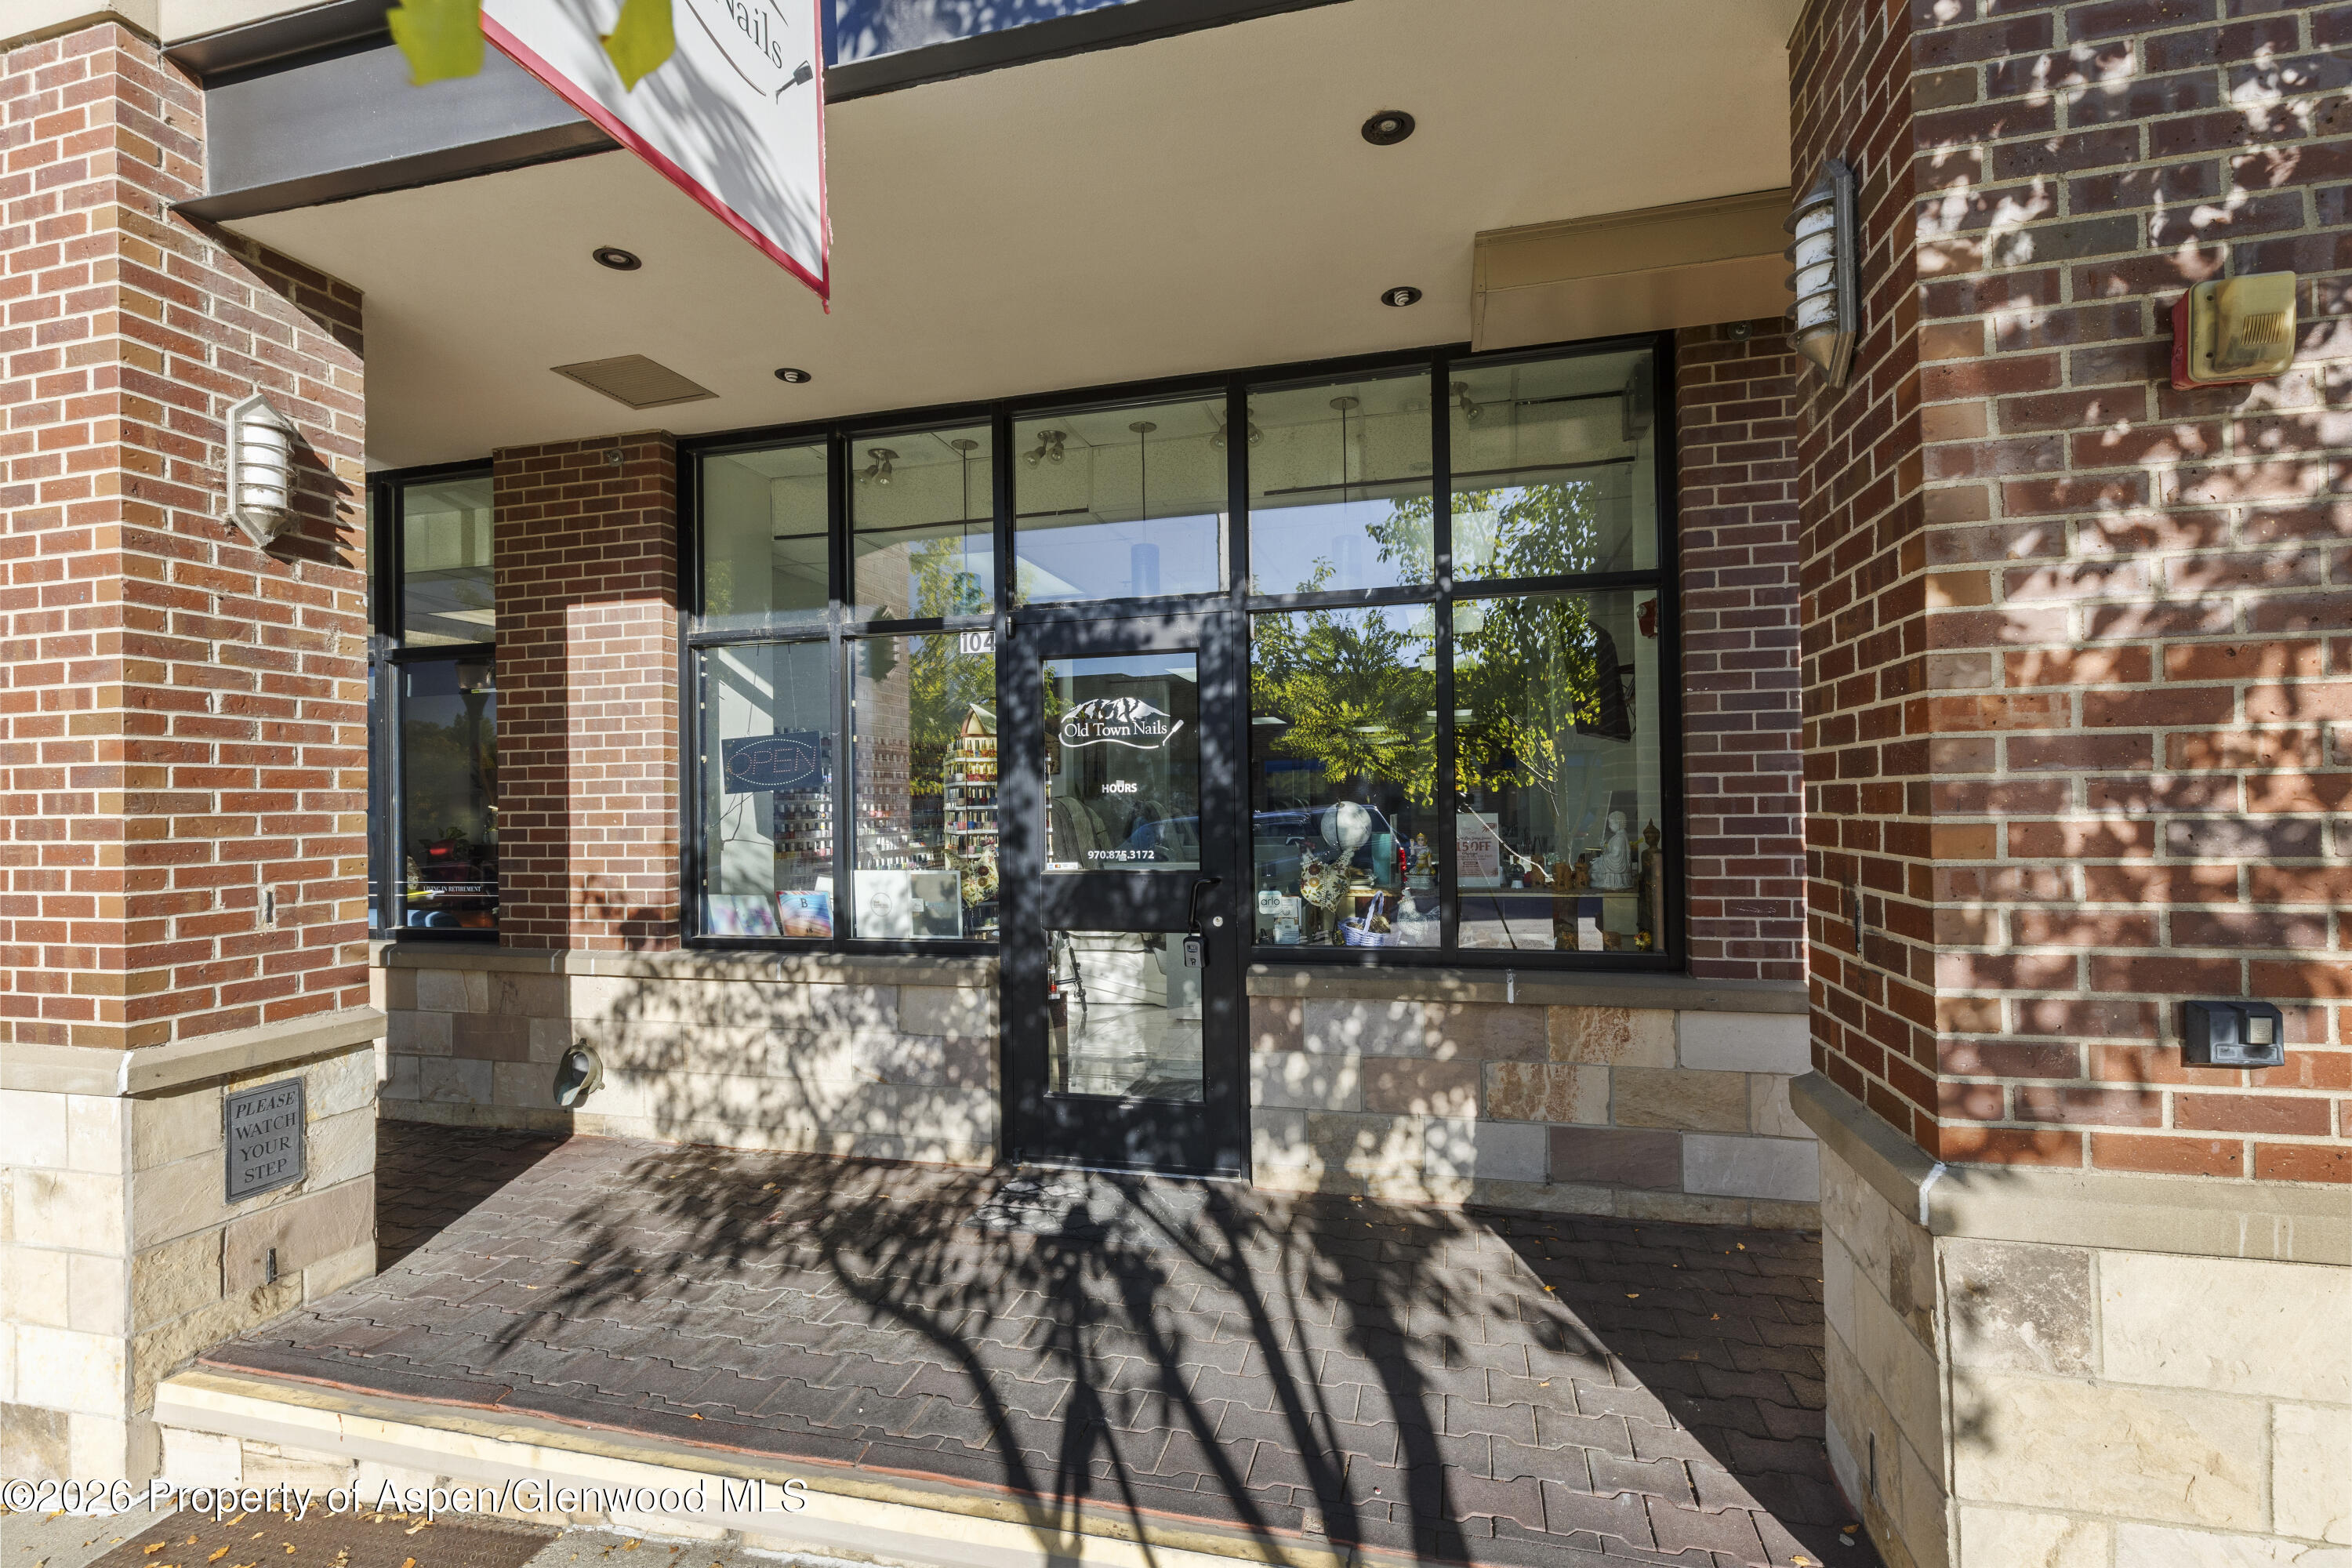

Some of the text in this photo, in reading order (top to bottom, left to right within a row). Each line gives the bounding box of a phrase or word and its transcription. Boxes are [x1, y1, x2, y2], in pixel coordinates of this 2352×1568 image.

[961, 631, 995, 652] 104
[1064, 720, 1167, 738] Old Town Nails
[727, 746, 817, 776] OPEN
[1102, 782, 1138, 793] HOURS
[1087, 850, 1155, 859] 970.875.3172
[1471, 841, 1491, 851] OFF
[1261, 896, 1280, 906] arlo
[234, 1091, 296, 1120] PLEASE
[236, 1112, 296, 1141] WATCH
[240, 1136, 292, 1162] YOUR
[244, 1158, 287, 1184] STEP
